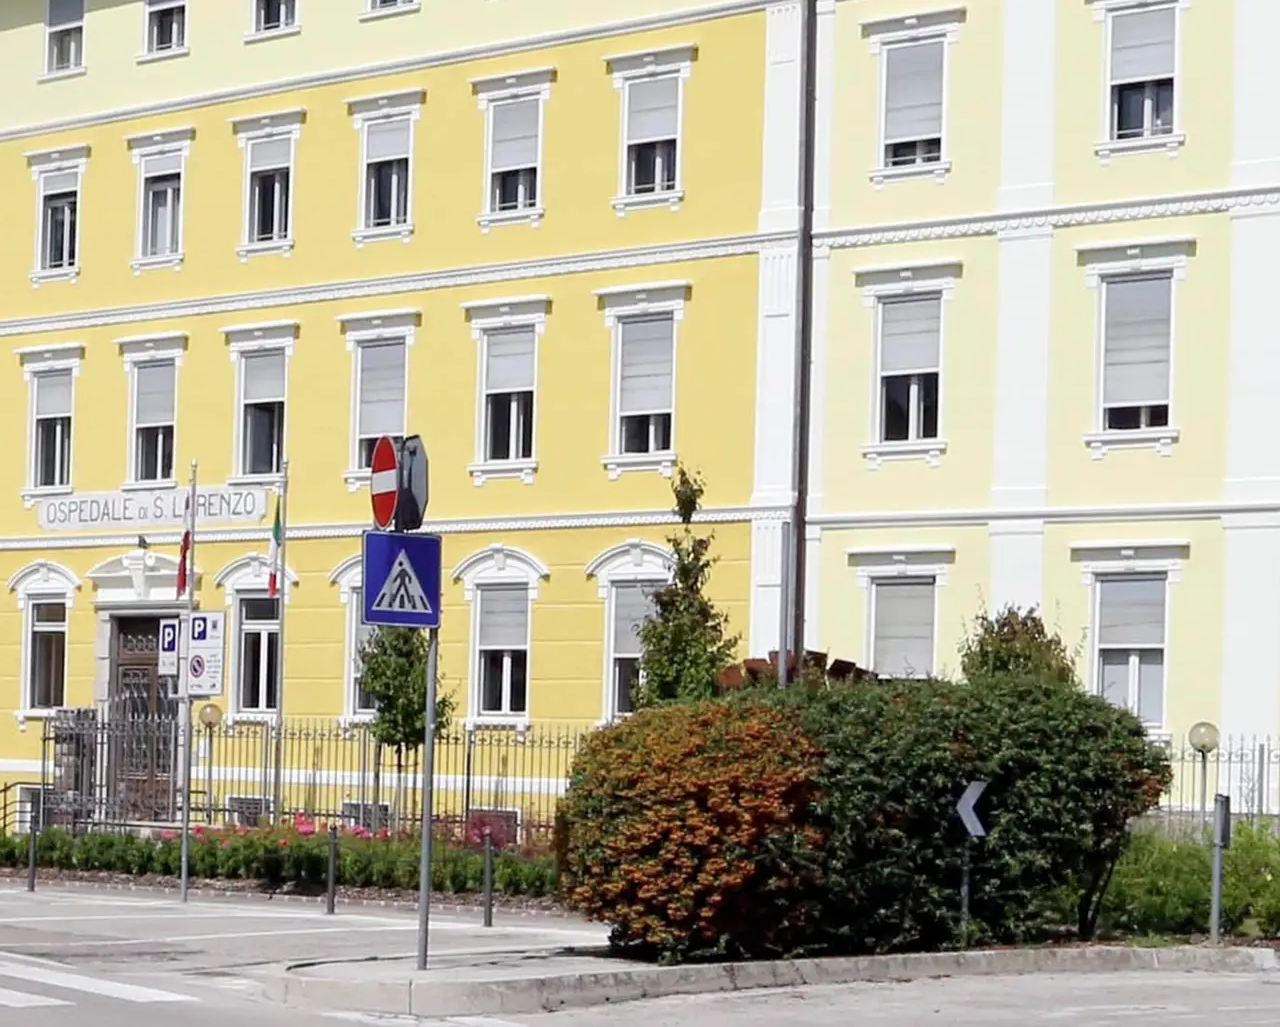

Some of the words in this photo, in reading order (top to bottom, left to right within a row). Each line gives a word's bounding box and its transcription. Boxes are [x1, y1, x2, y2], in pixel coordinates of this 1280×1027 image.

[46, 497, 133, 524] OSPEDALE
[153, 496, 168, 519] S.
[172, 491, 256, 519] LRENZO
[163, 627, 174, 650] P
[193, 619, 205, 639] P
